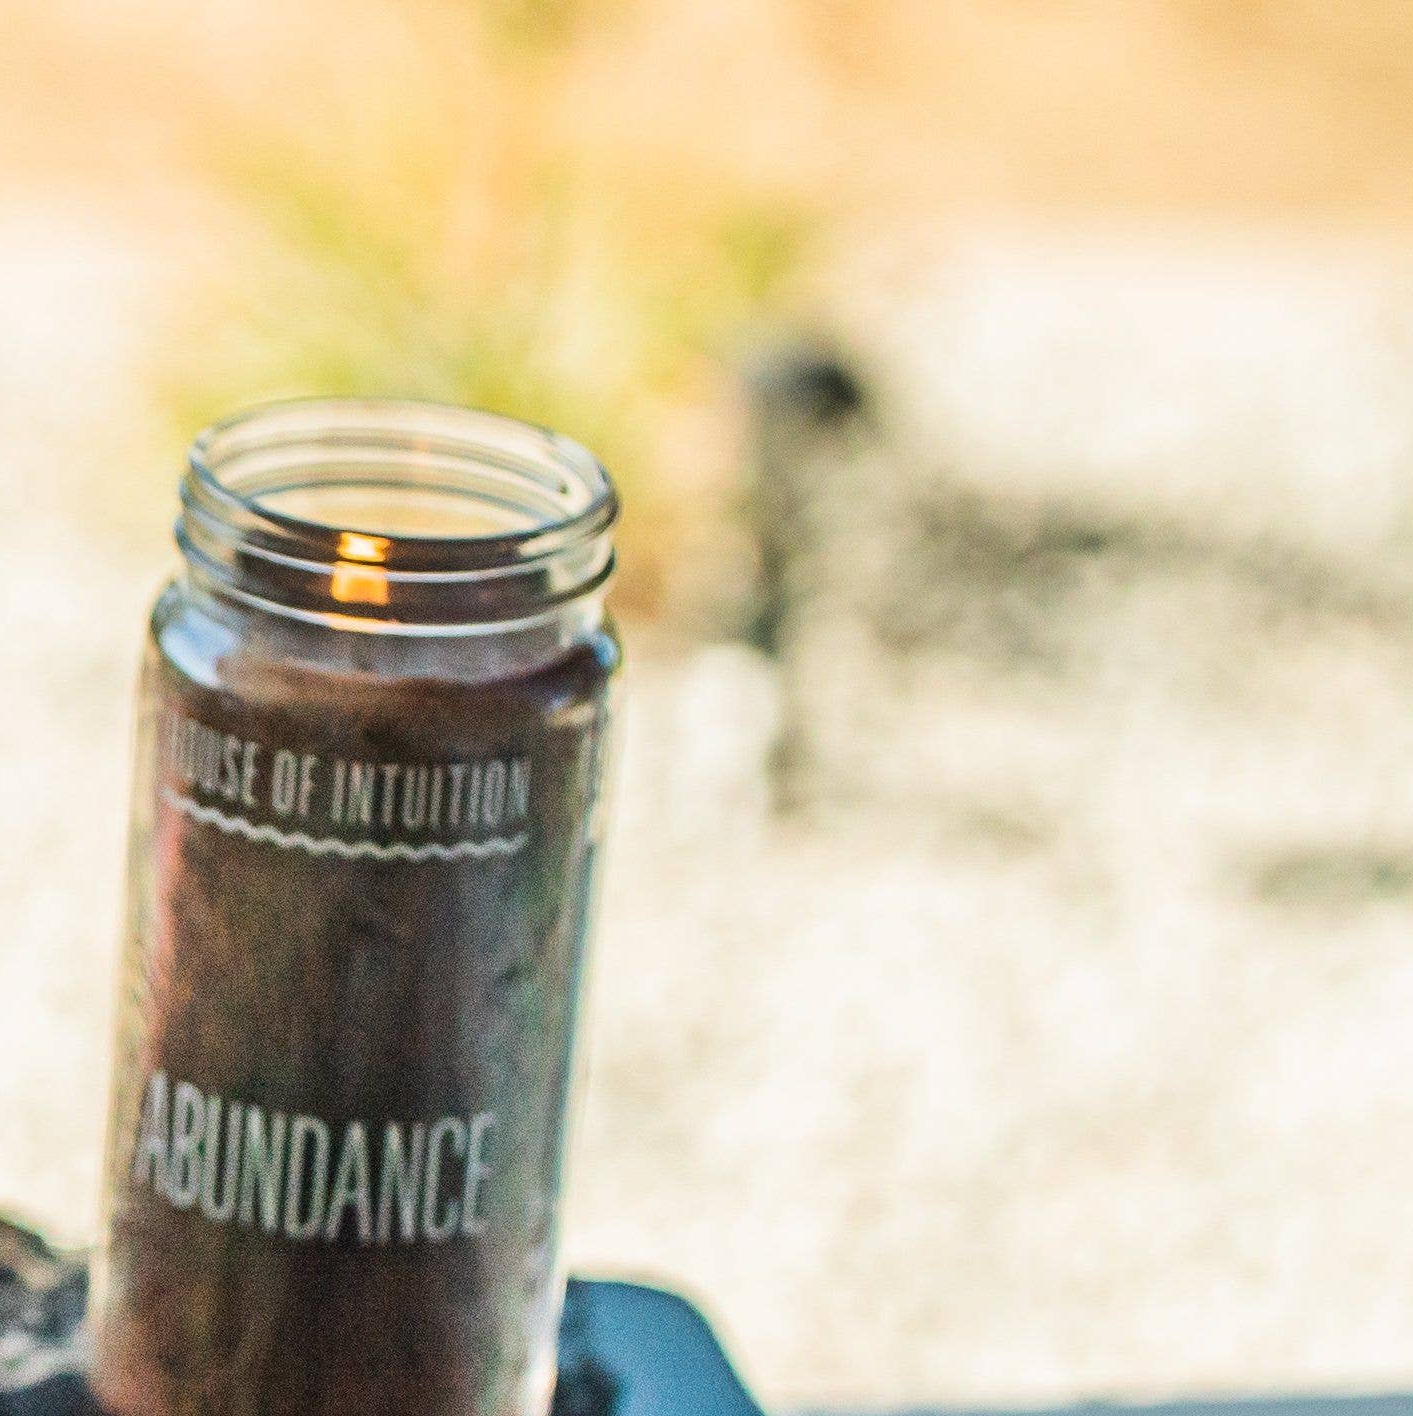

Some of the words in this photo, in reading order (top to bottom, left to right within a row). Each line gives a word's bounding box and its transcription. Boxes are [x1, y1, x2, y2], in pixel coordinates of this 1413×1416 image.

[271, 749, 320, 817] OF
[331, 755, 532, 830] INTUITION
[133, 1069, 498, 1244] ABUNDANCE
